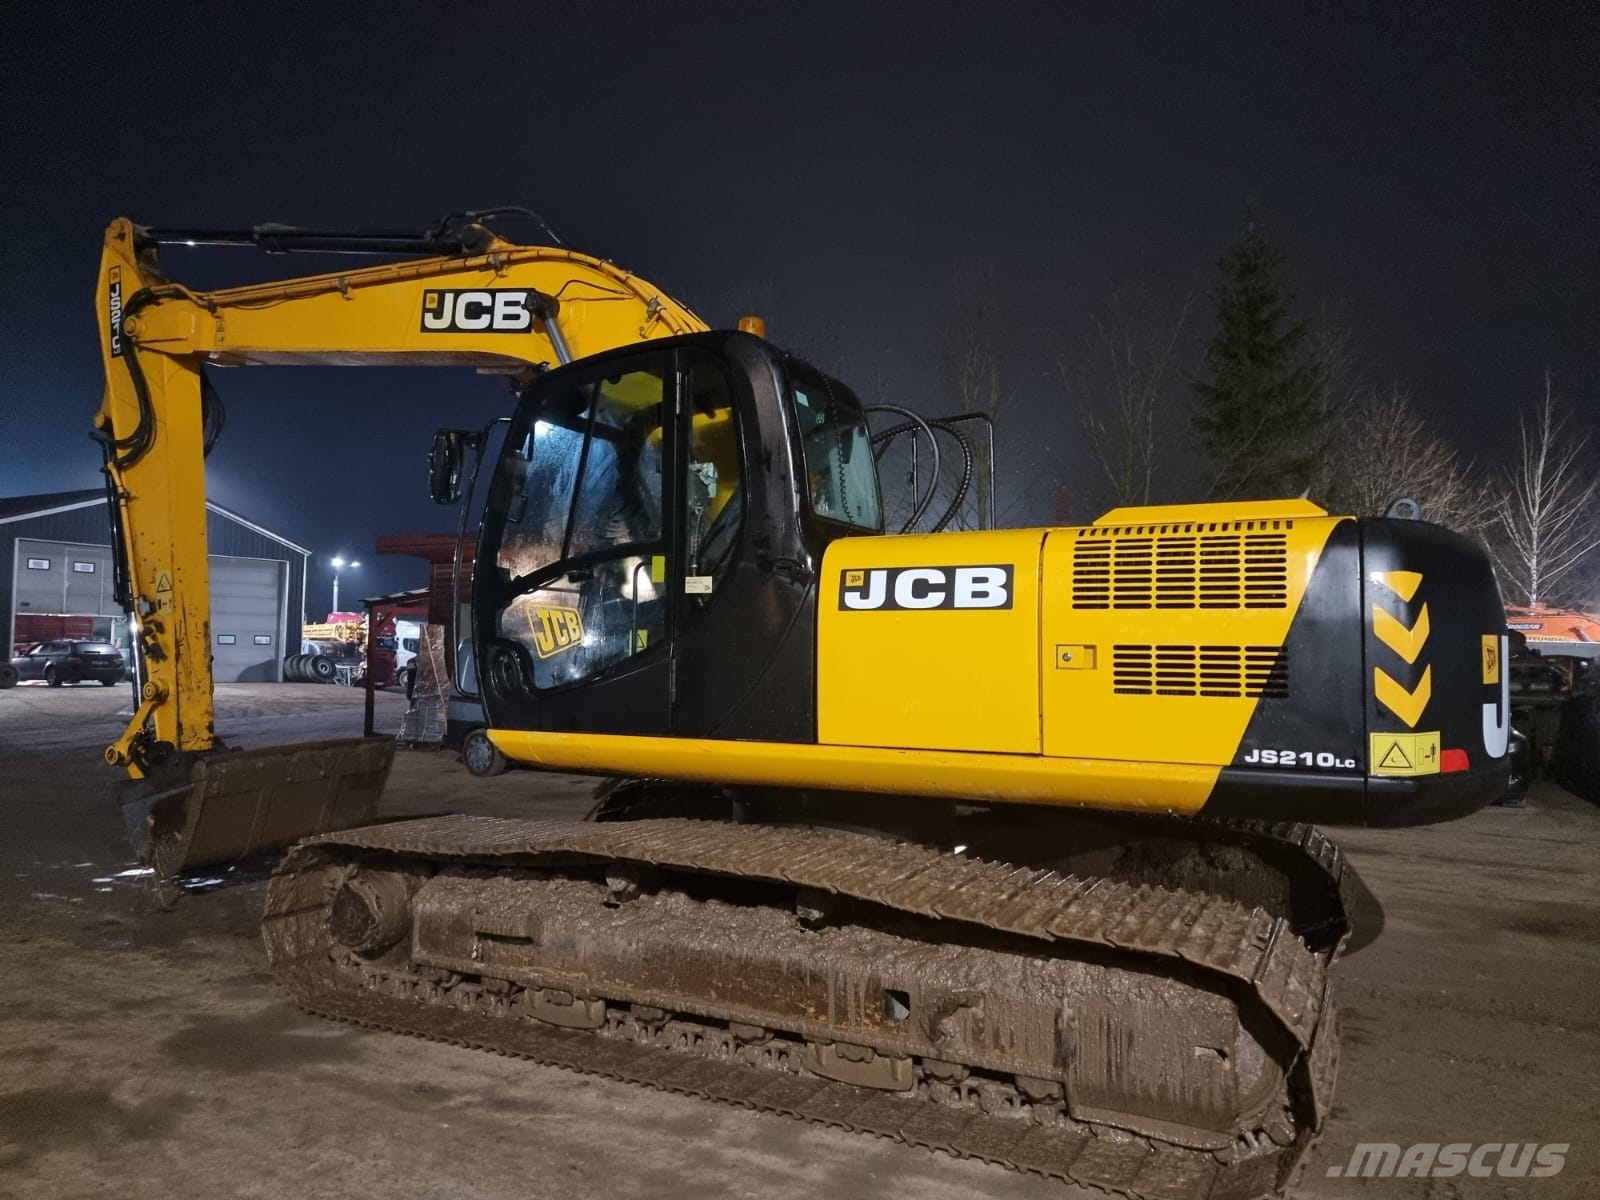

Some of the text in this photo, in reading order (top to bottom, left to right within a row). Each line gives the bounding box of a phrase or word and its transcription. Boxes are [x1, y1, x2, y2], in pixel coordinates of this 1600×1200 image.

[424, 292, 530, 329] JCB
[844, 567, 1008, 609] JCB
[536, 608, 581, 652] JCB
